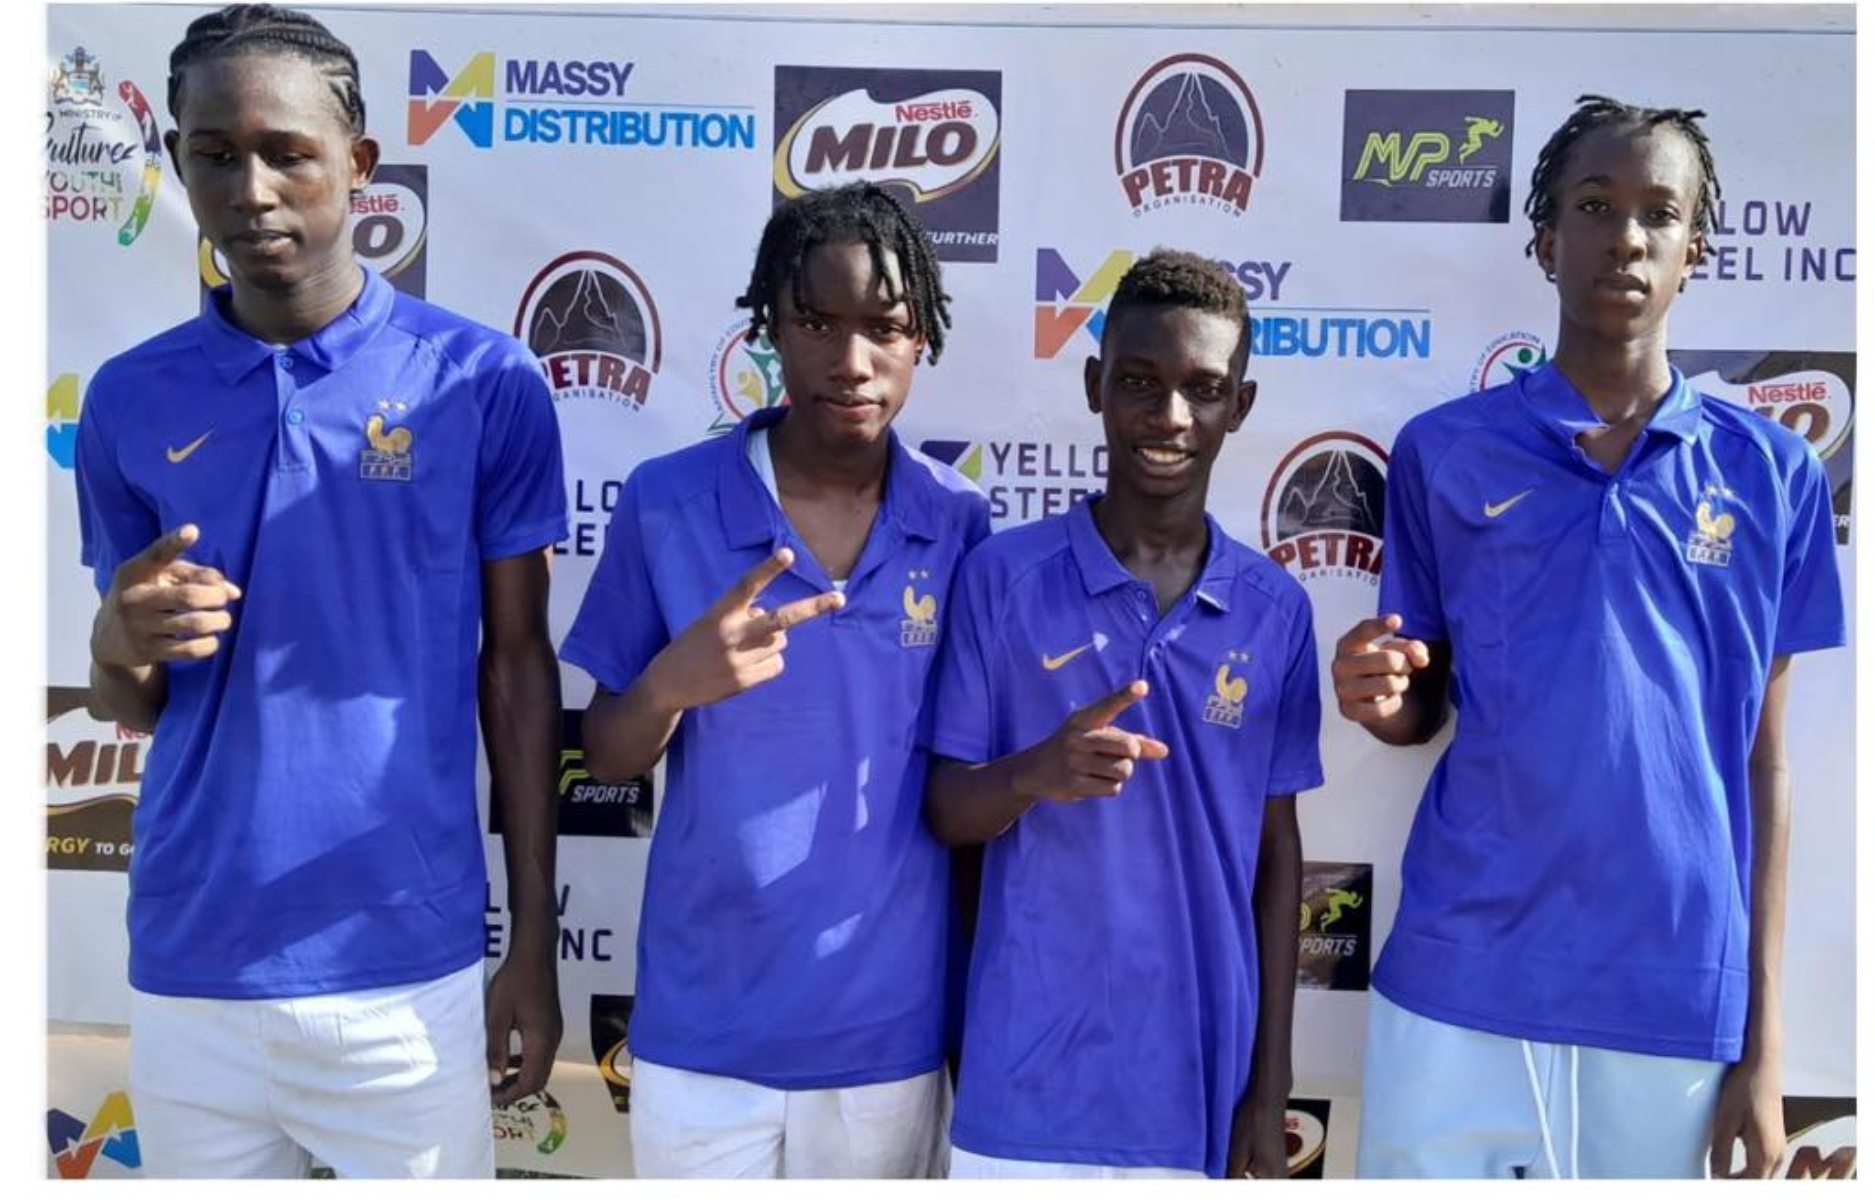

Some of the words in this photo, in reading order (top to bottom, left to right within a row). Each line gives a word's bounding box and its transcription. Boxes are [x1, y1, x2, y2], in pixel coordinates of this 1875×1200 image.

[506, 60, 634, 97] MASSY
[505, 109, 755, 149] DISTRIBUTION
[895, 100, 973, 124] Nestlé
[805, 121, 978, 175] MILO
[1354, 132, 1449, 182] MVP
[1120, 158, 1253, 214] PETRA
[1426, 168, 1497, 188] SPORTS
[1132, 196, 1243, 218] ORGANISATION
[1249, 318, 1431, 359] RIBUTION
[542, 353, 654, 407] ETRA
[1748, 382, 1827, 405] Nestlé
[990, 442, 1108, 479] YELLO
[46, 740, 143, 787] MIL
[572, 785, 640, 804] SPORTS
[96, 841, 116, 856] TO
[1300, 938, 1357, 958] PORTS
